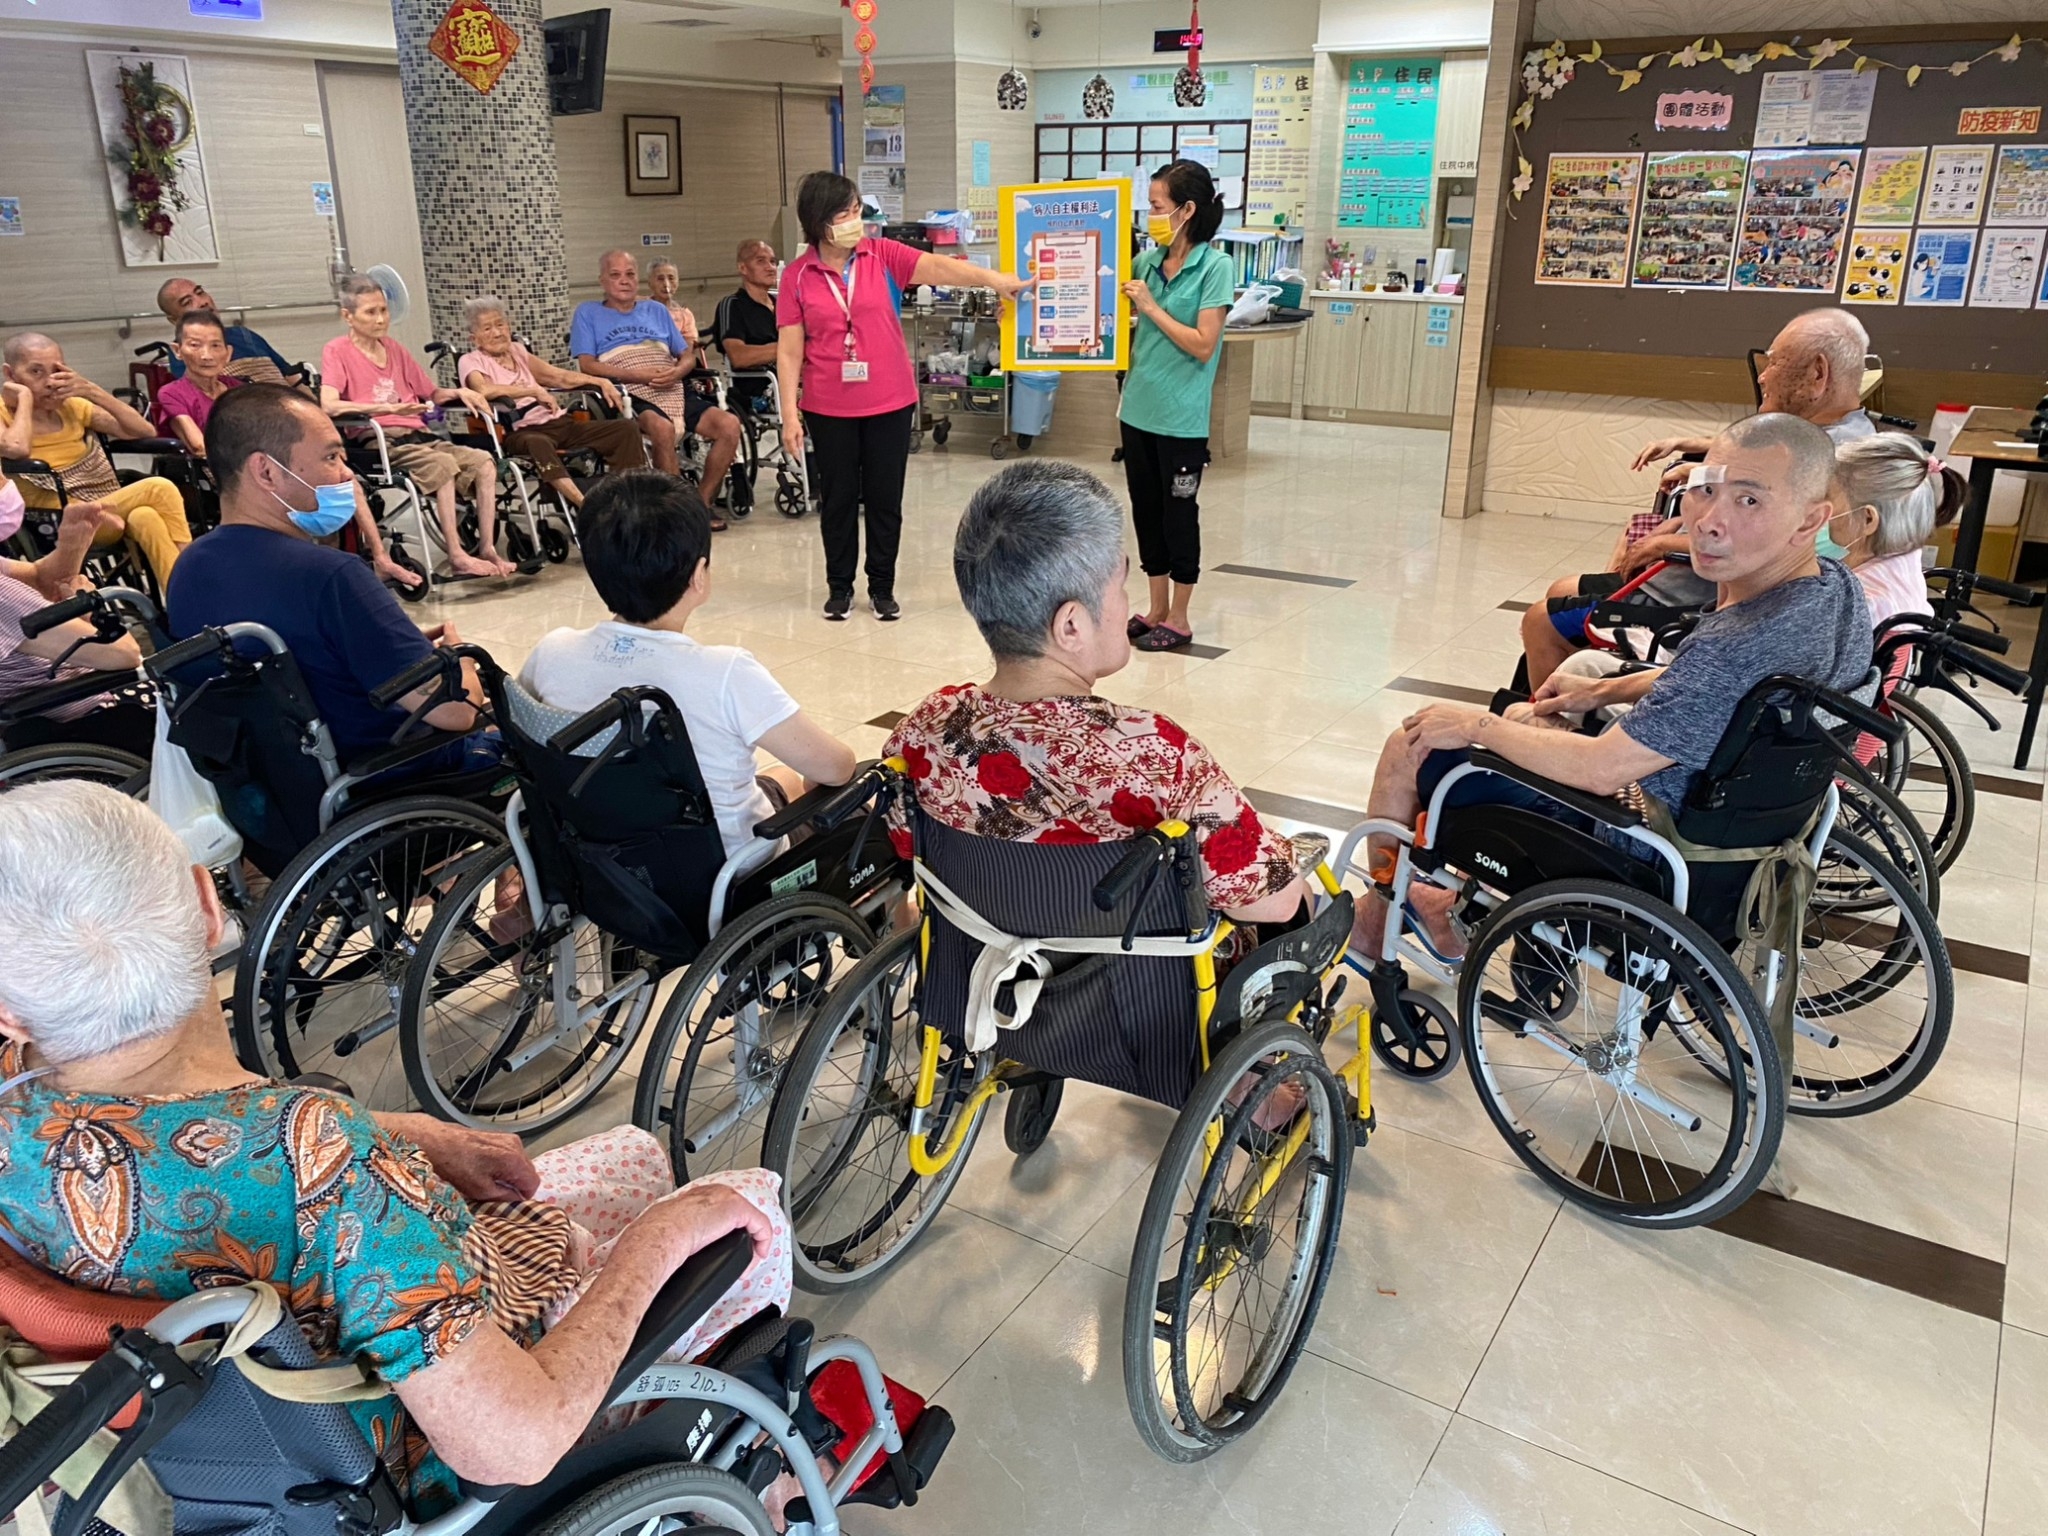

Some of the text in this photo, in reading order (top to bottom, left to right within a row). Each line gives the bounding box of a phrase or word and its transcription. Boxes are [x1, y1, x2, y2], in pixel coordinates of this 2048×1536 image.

[1394, 66, 1433, 85] 住民
[1663, 101, 1726, 118] 團體活動
[1960, 109, 2039, 133] 防疫新知
[1439, 160, 1478, 171] 住院中病
[1034, 201, 1099, 216] 病人自主權利法
[1474, 851, 1509, 878] SOMA
[850, 863, 876, 889] SOMA
